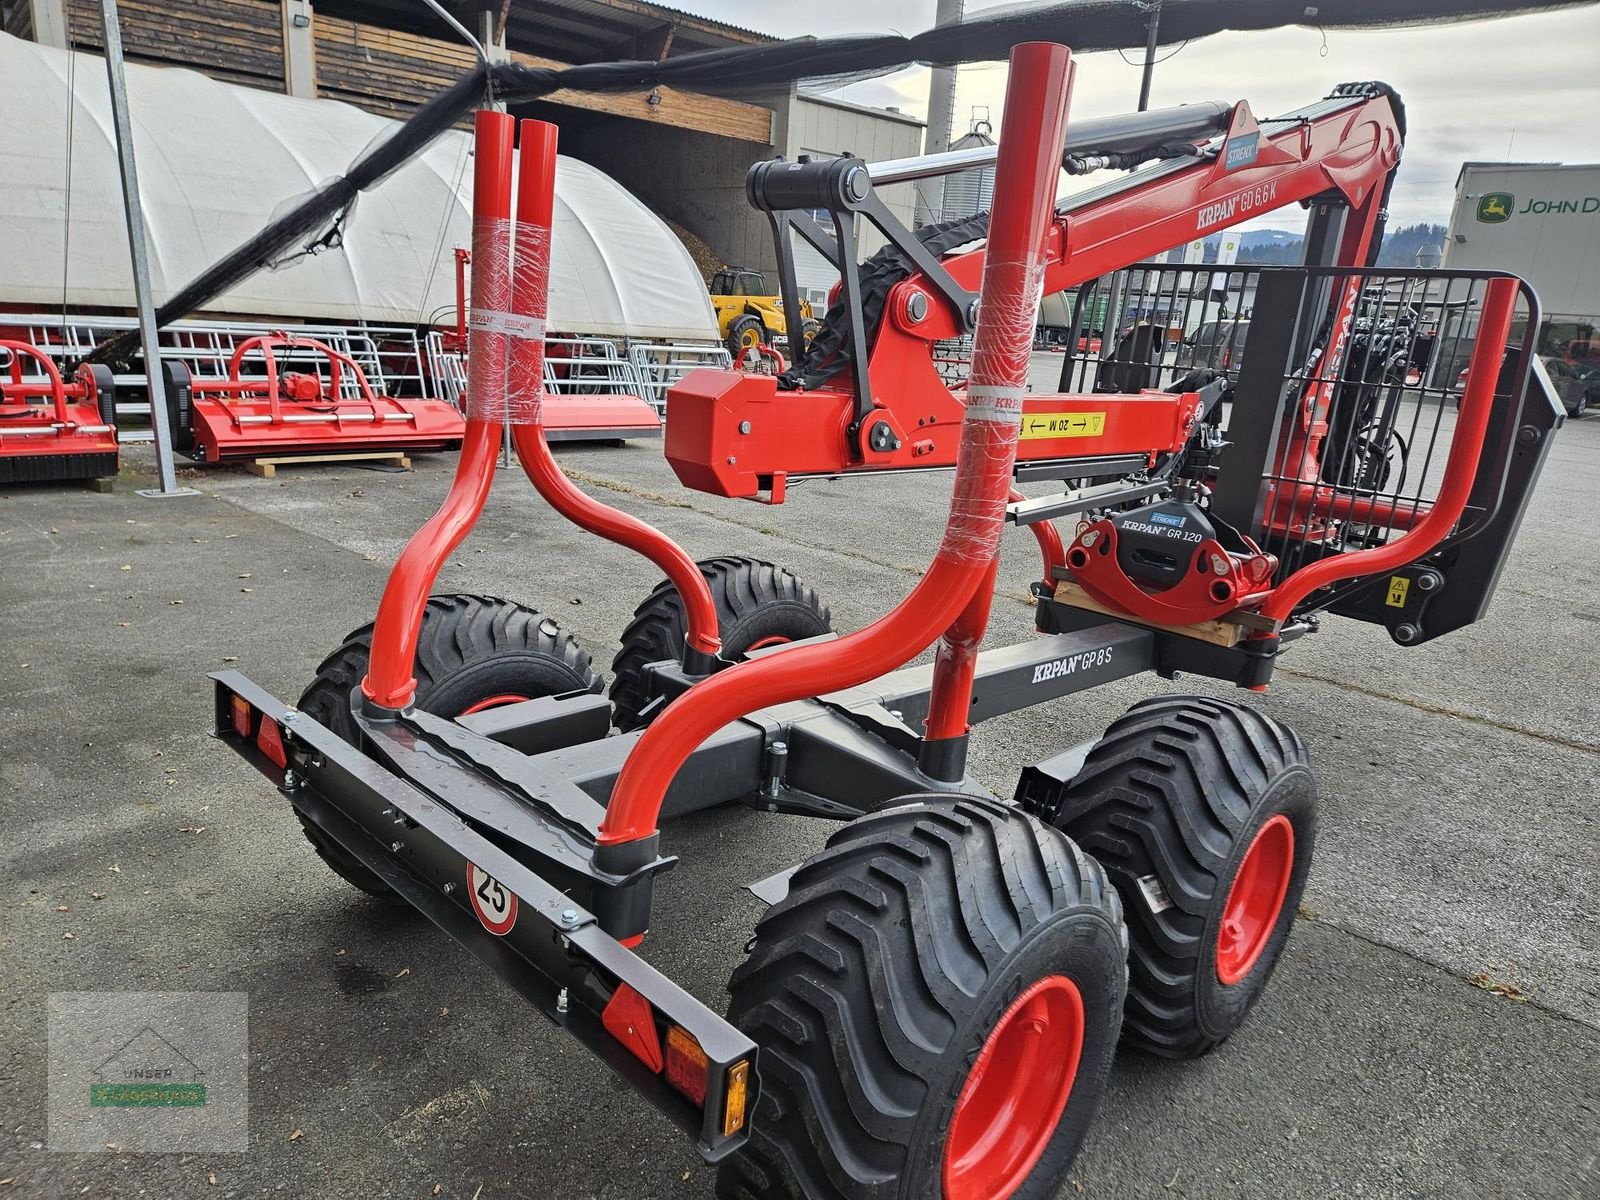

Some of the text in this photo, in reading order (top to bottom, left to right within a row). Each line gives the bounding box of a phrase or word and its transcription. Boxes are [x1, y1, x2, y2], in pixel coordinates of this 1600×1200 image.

[1240, 191, 1253, 212] GD
[1254, 184, 1269, 207] 6,6
[1270, 181, 1278, 201] K
[1519, 197, 1600, 214] JOHN D
[1049, 419, 1069, 431] 20 M
[1167, 529, 1181, 539] GR
[1183, 531, 1202, 543] 120
[1081, 651, 1097, 670] GP
[1097, 649, 1105, 666] 8
[1105, 646, 1113, 663] S
[477, 869, 506, 913] 25
